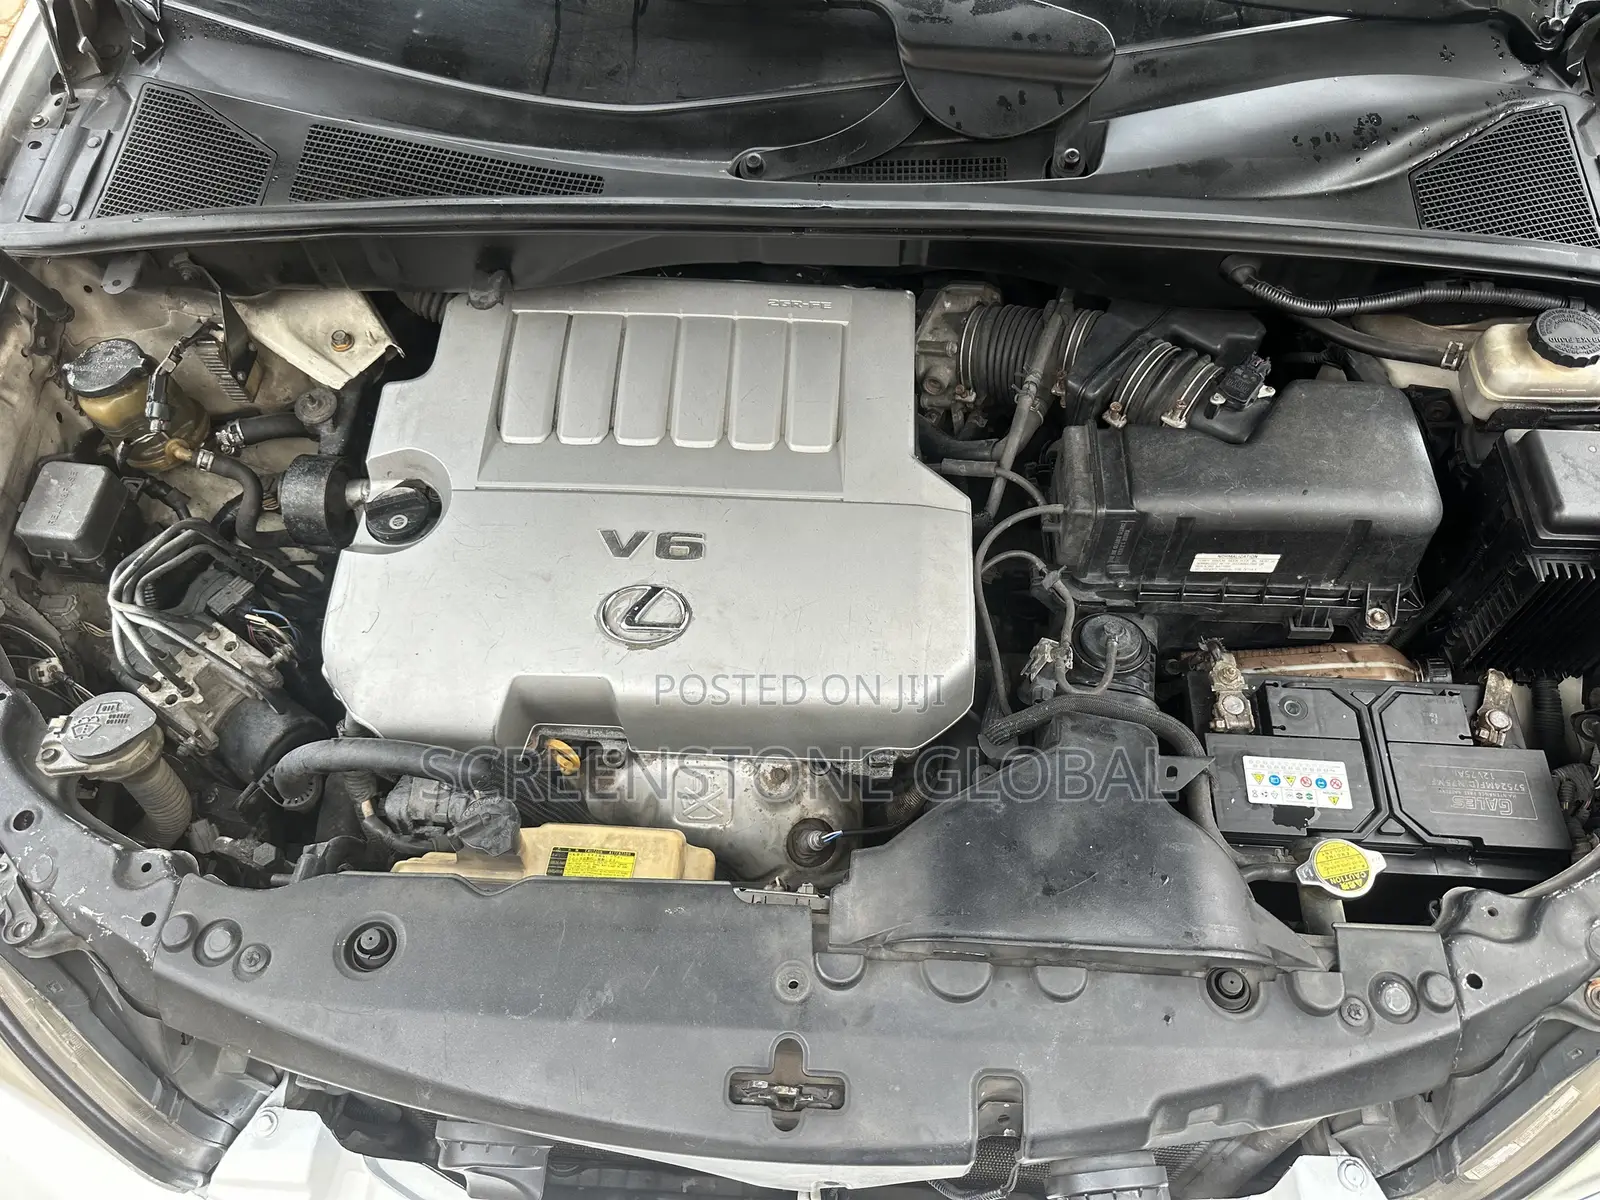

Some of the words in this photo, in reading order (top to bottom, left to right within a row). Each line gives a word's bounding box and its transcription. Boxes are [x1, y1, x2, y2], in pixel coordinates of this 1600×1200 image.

[596, 529, 706, 561] V6
[1451, 795, 1513, 816] GALES
[1329, 871, 1367, 884] CAUTION
